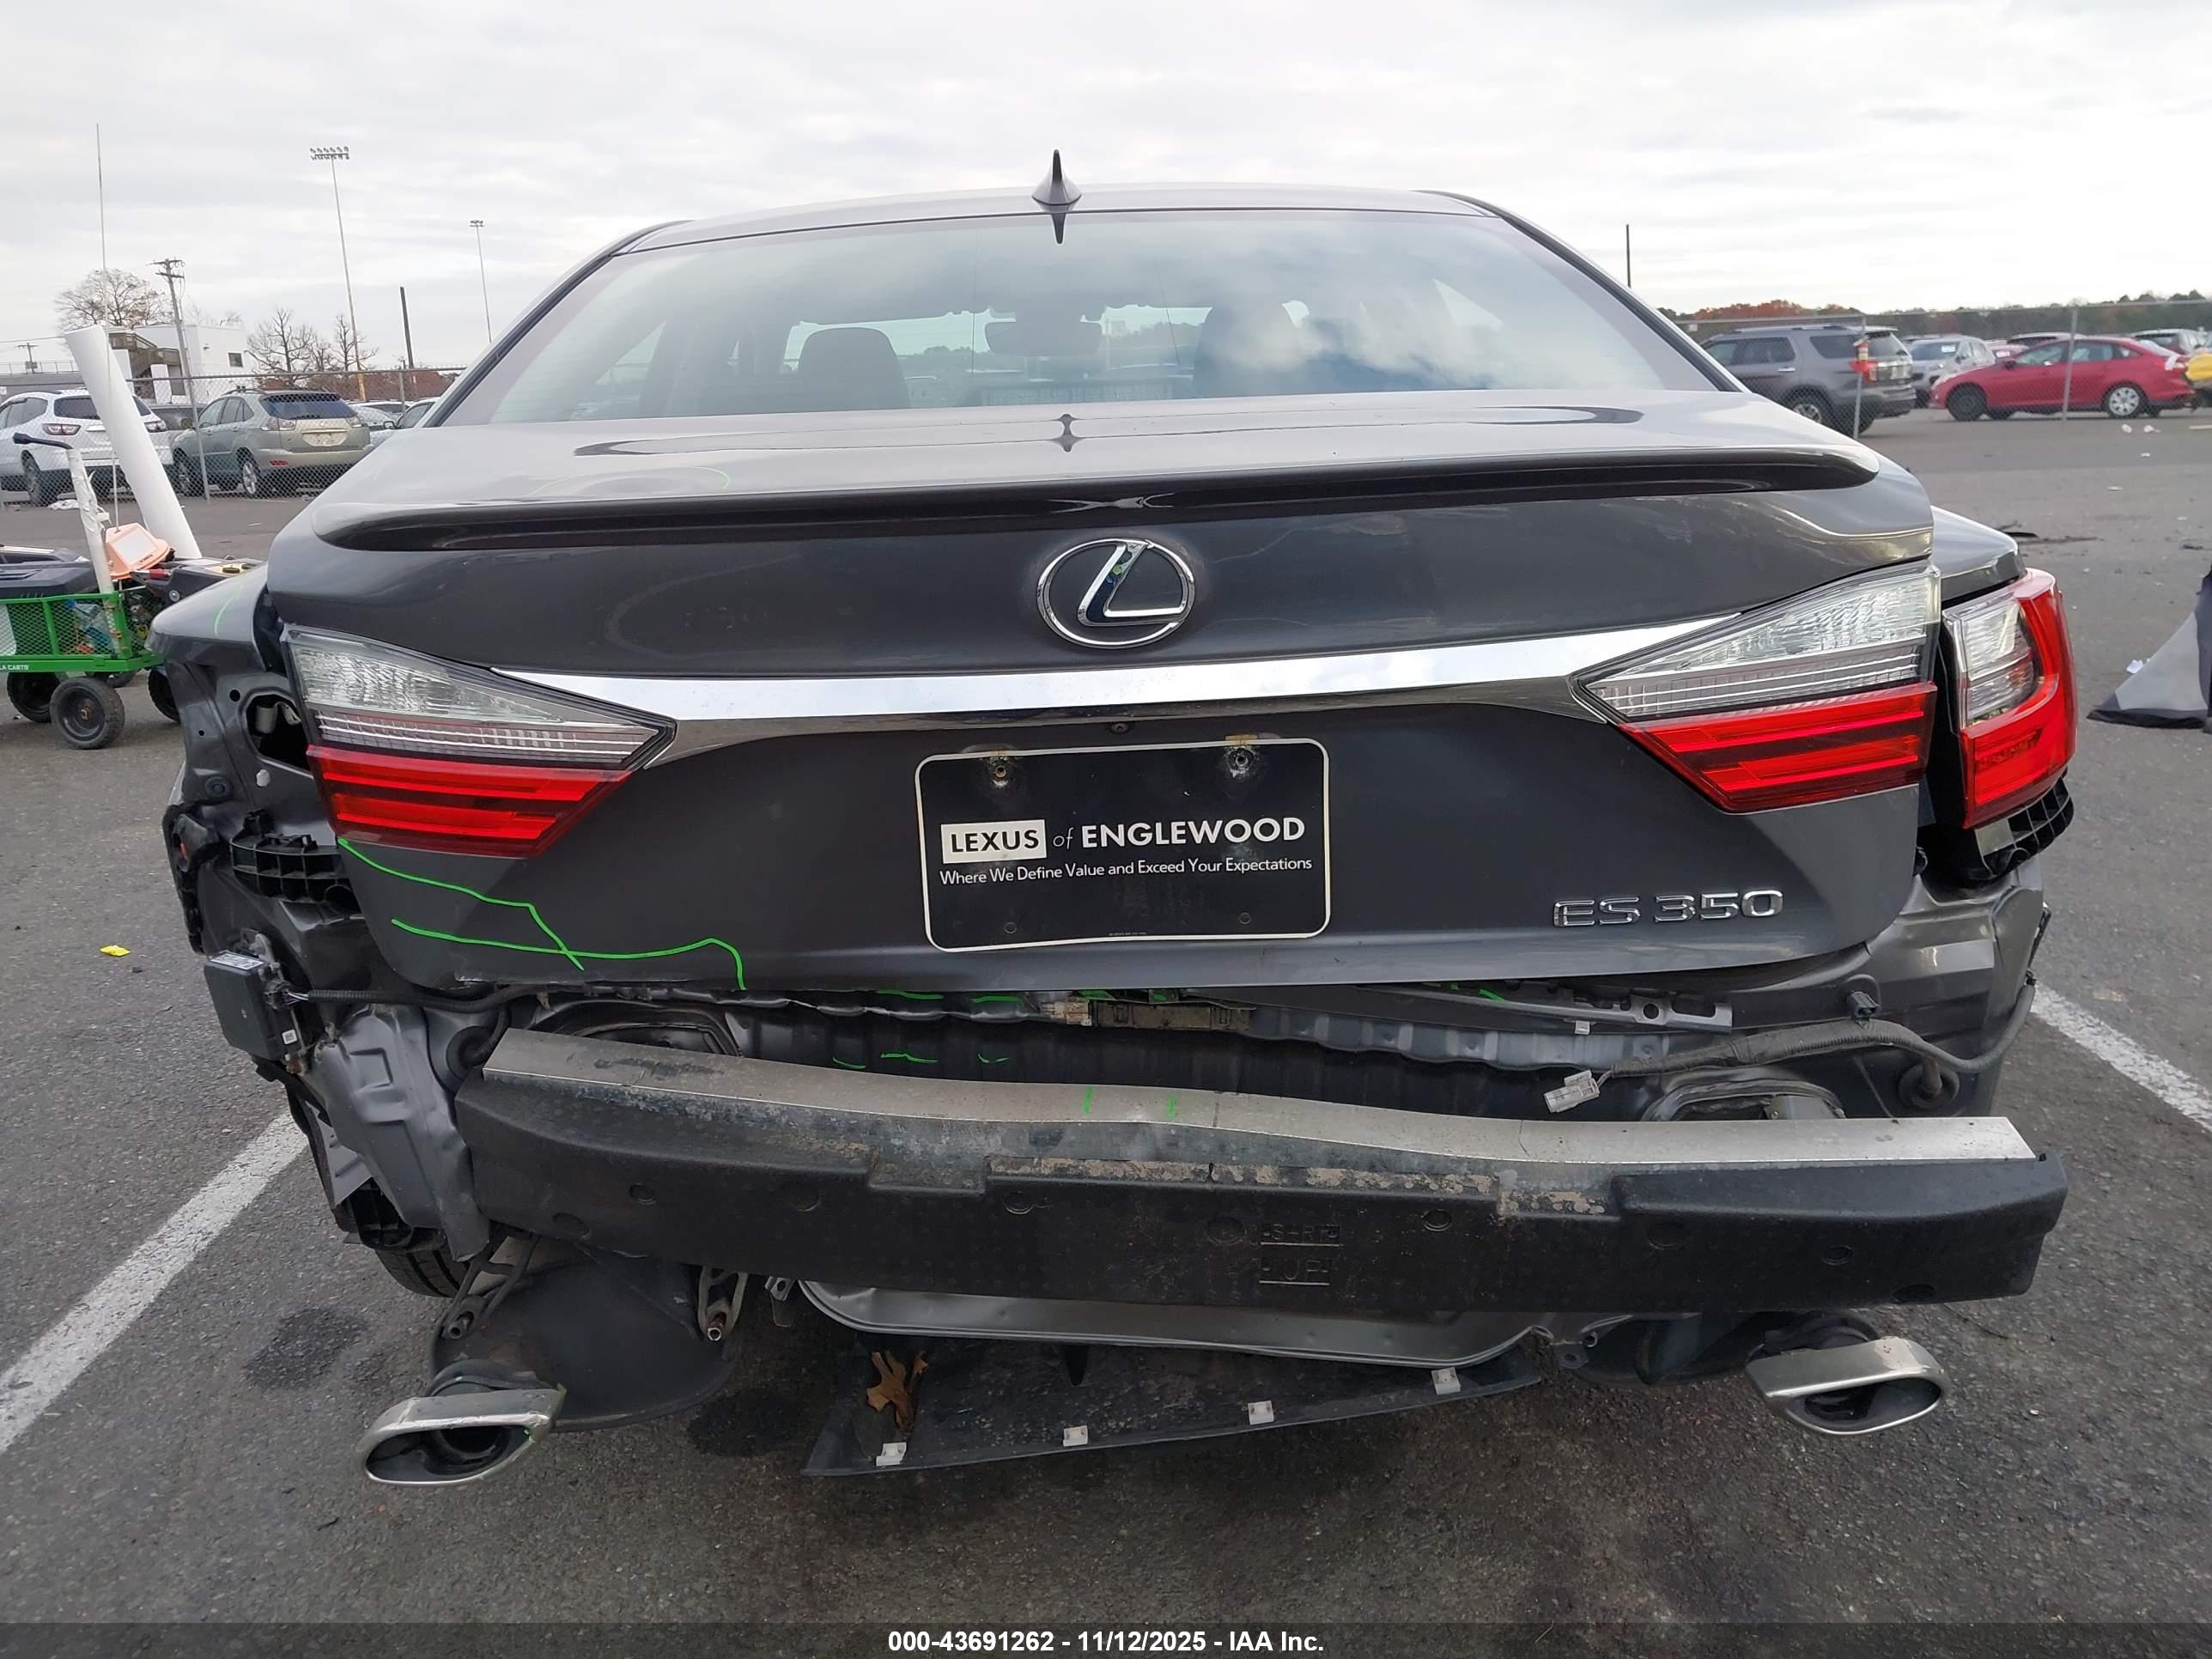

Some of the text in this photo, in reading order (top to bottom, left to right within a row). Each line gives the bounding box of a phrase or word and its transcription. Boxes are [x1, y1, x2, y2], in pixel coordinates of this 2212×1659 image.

[951, 817, 1305, 853] LEXUS of ENGLEWOOD
[939, 857, 1313, 885] Where We Define Value and Exceed Your Expectations
[1553, 890, 1784, 927] ES 350
